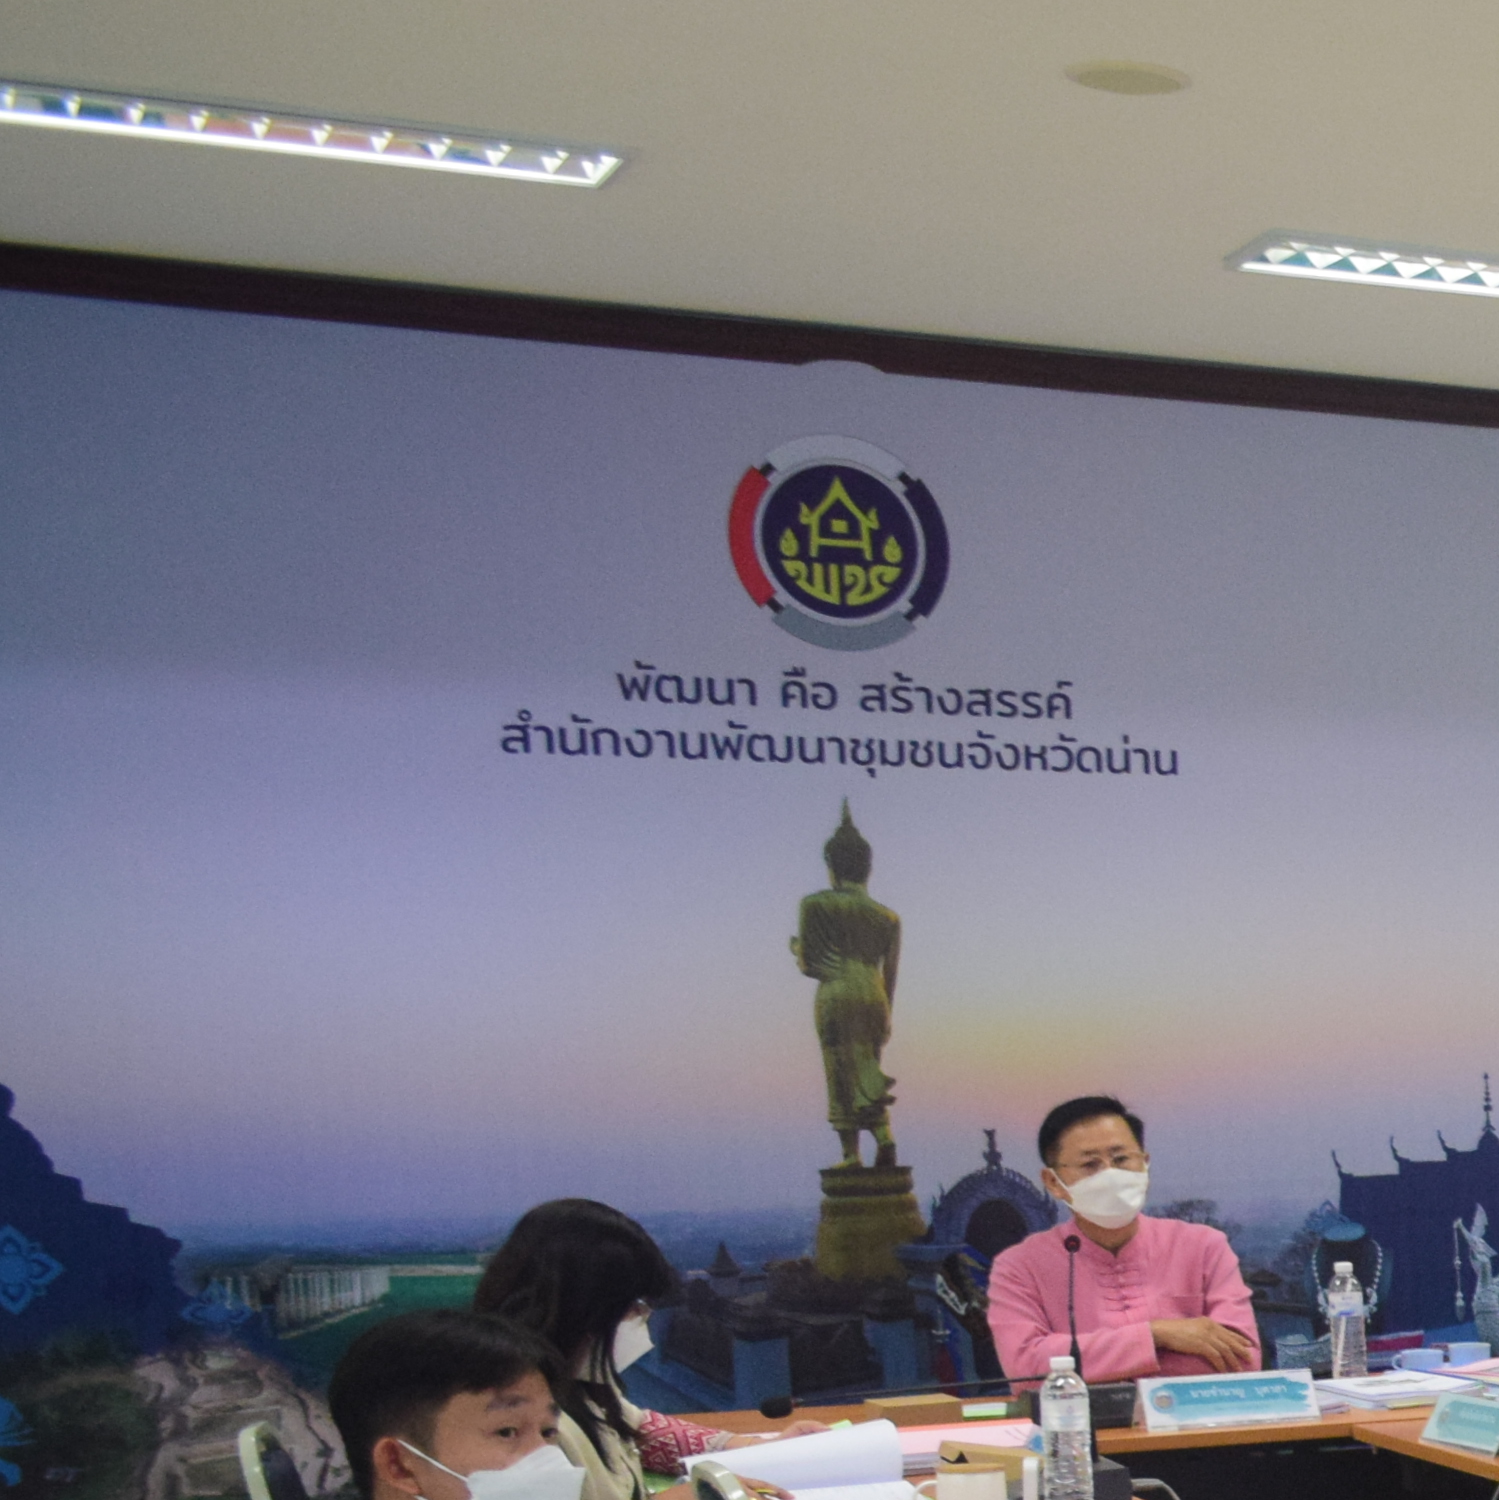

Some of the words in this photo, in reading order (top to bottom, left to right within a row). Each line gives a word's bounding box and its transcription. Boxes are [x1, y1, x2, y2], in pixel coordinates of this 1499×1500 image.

[616, 659, 758, 707] พัฒนา
[780, 666, 838, 711] คือ
[859, 671, 1074, 720] สร้างสรรค์
[500, 710, 1179, 777] สำนักงานพัฒนาชุมชนจังหวัดน่าน
